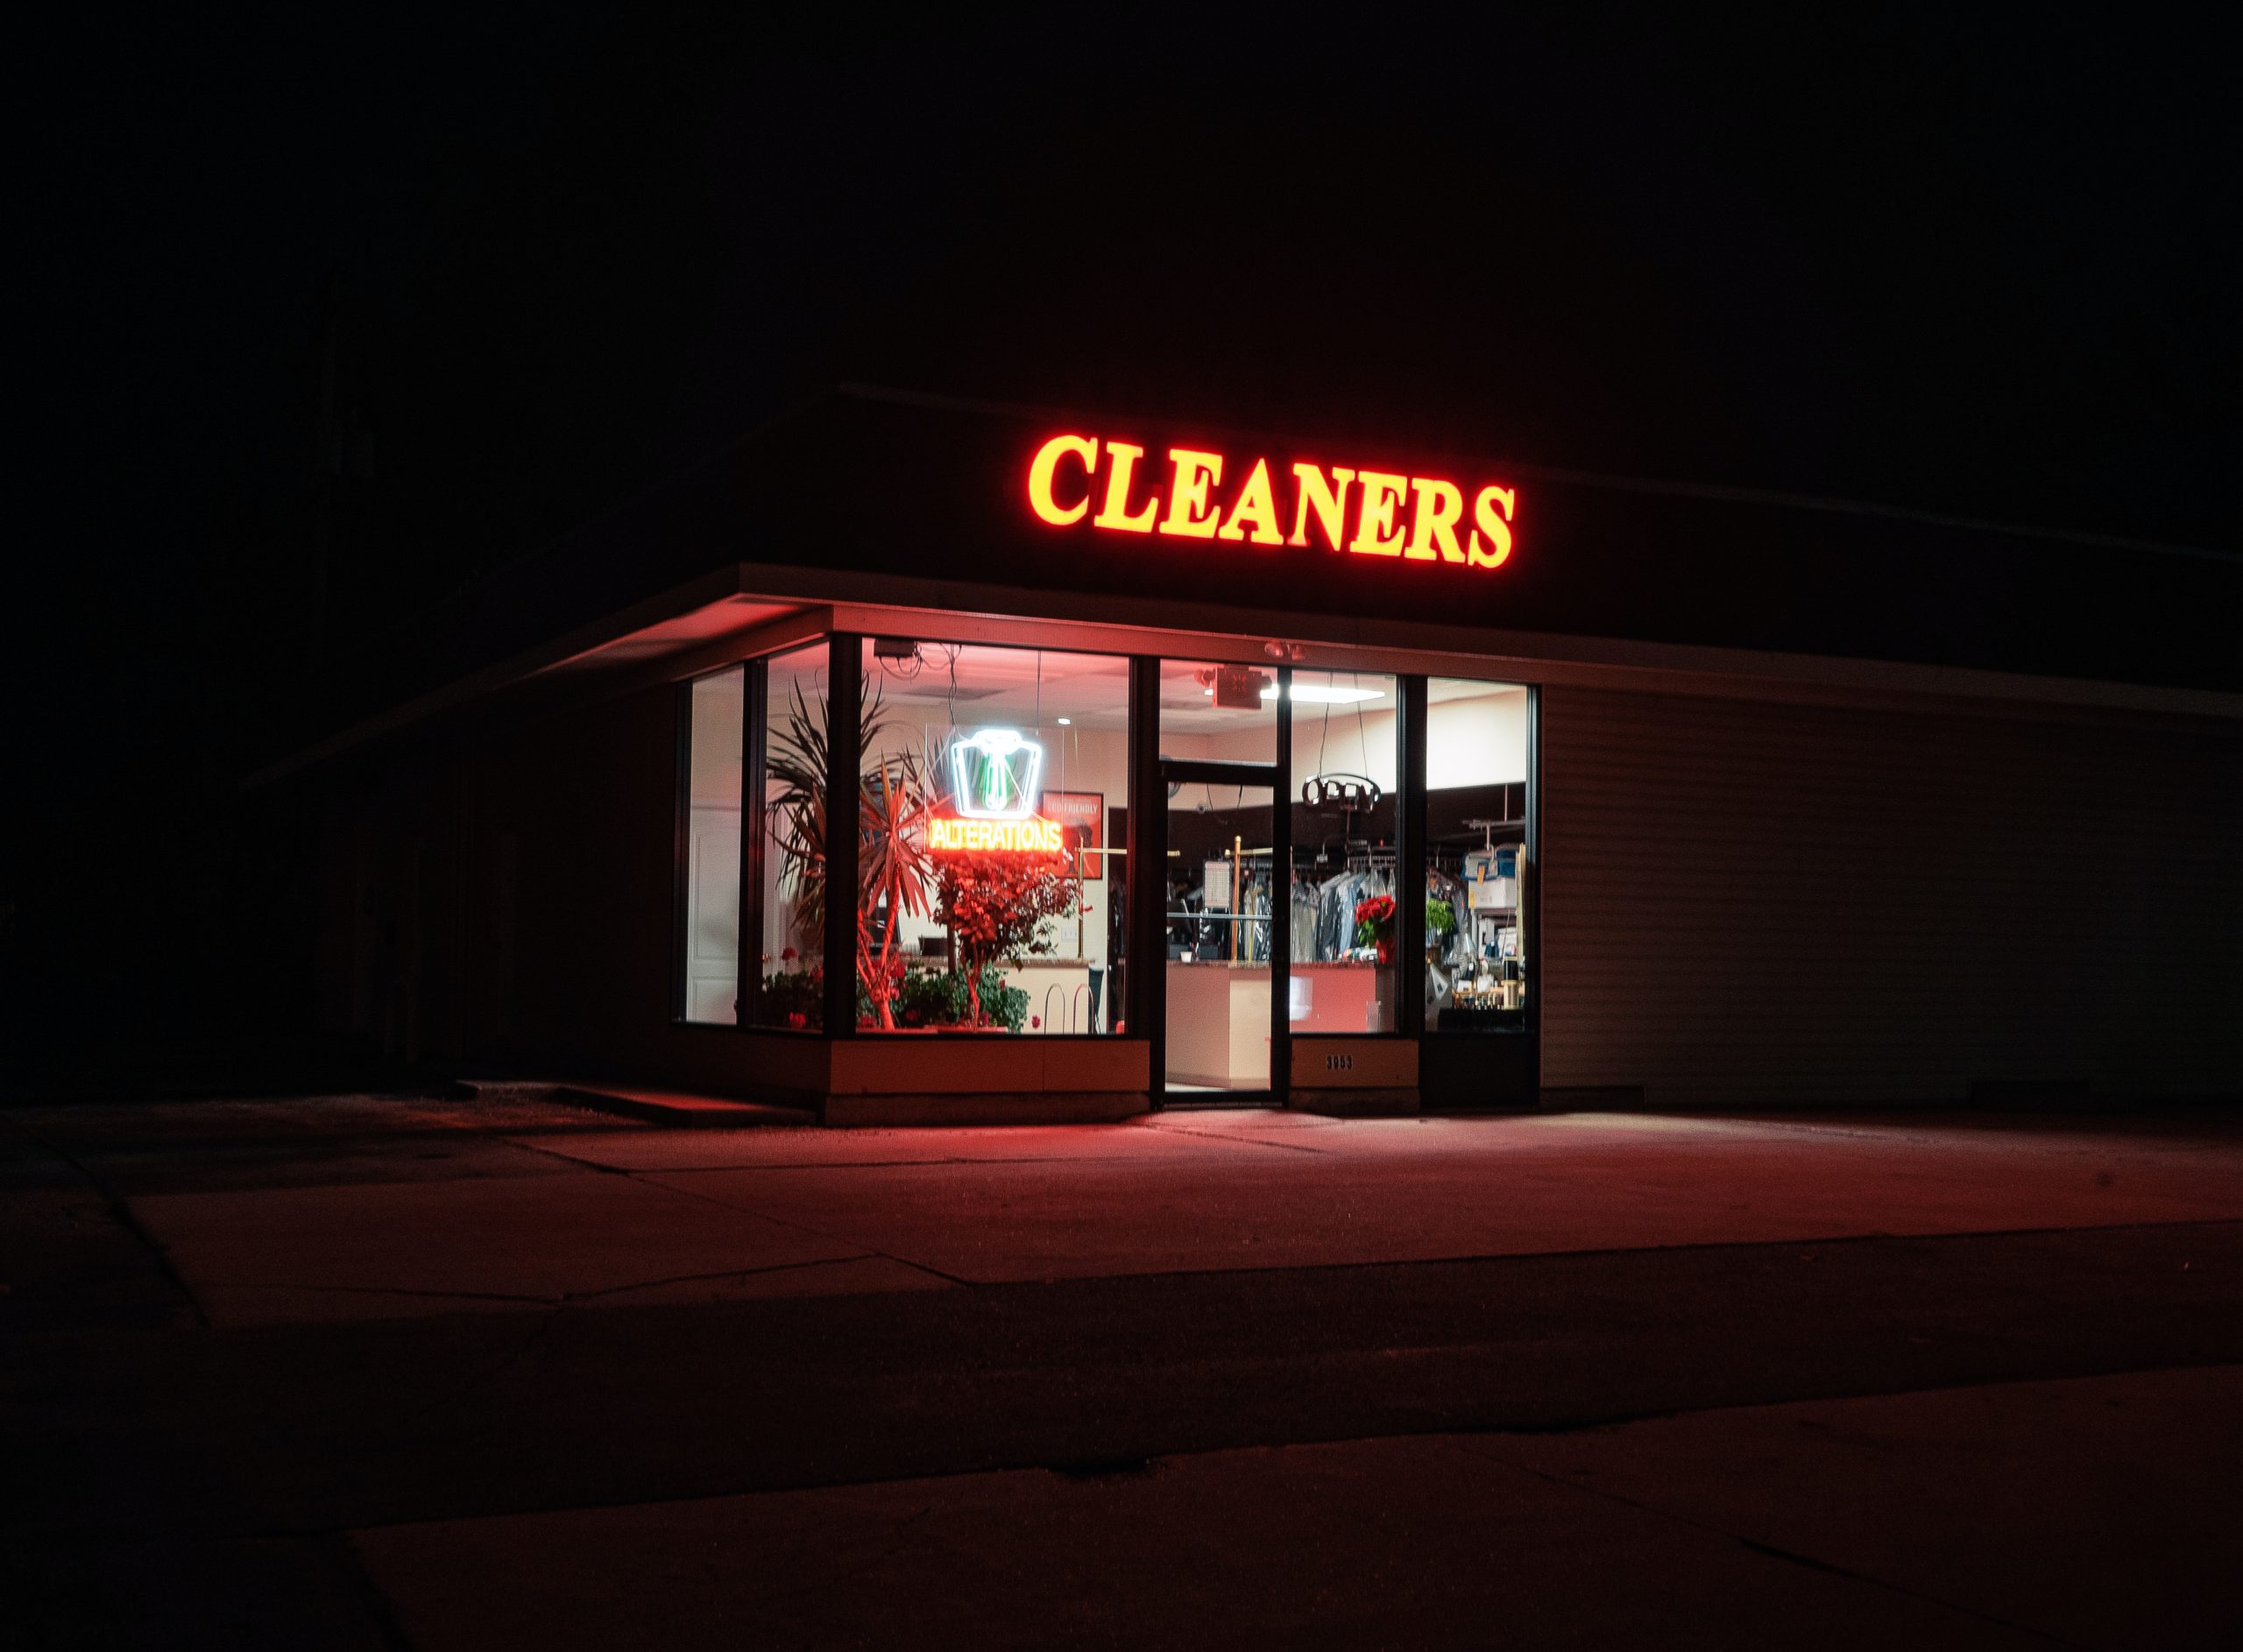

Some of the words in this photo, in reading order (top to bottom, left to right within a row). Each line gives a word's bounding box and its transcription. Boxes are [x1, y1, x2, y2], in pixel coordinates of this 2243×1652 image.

[1029, 434, 1515, 568] CLEANERS
[1302, 777, 1375, 813] OPEN
[930, 819, 1062, 850] ALTERATIONS
